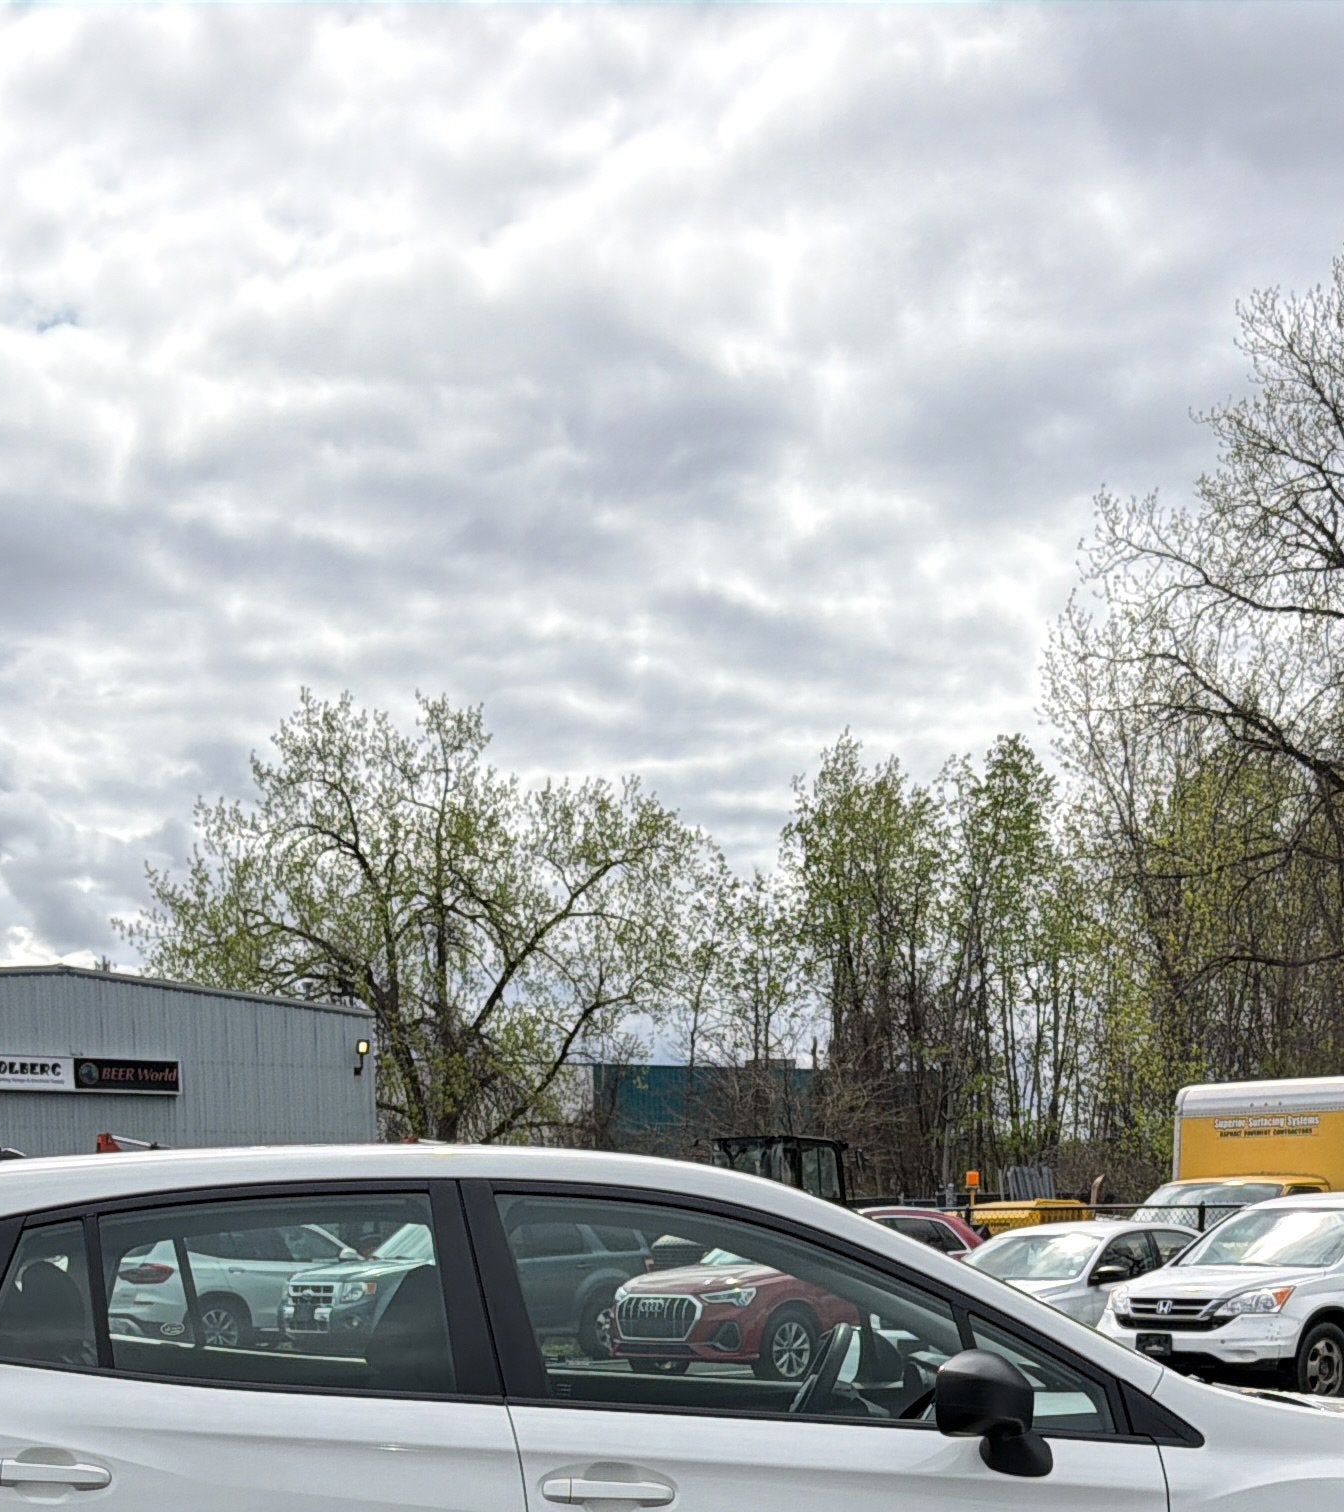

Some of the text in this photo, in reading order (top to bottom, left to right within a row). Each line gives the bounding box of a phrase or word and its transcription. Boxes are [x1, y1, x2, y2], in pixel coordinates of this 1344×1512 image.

[102, 1067, 176, 1081] BEER World
[1287, 1115, 1320, 1127] Systems
